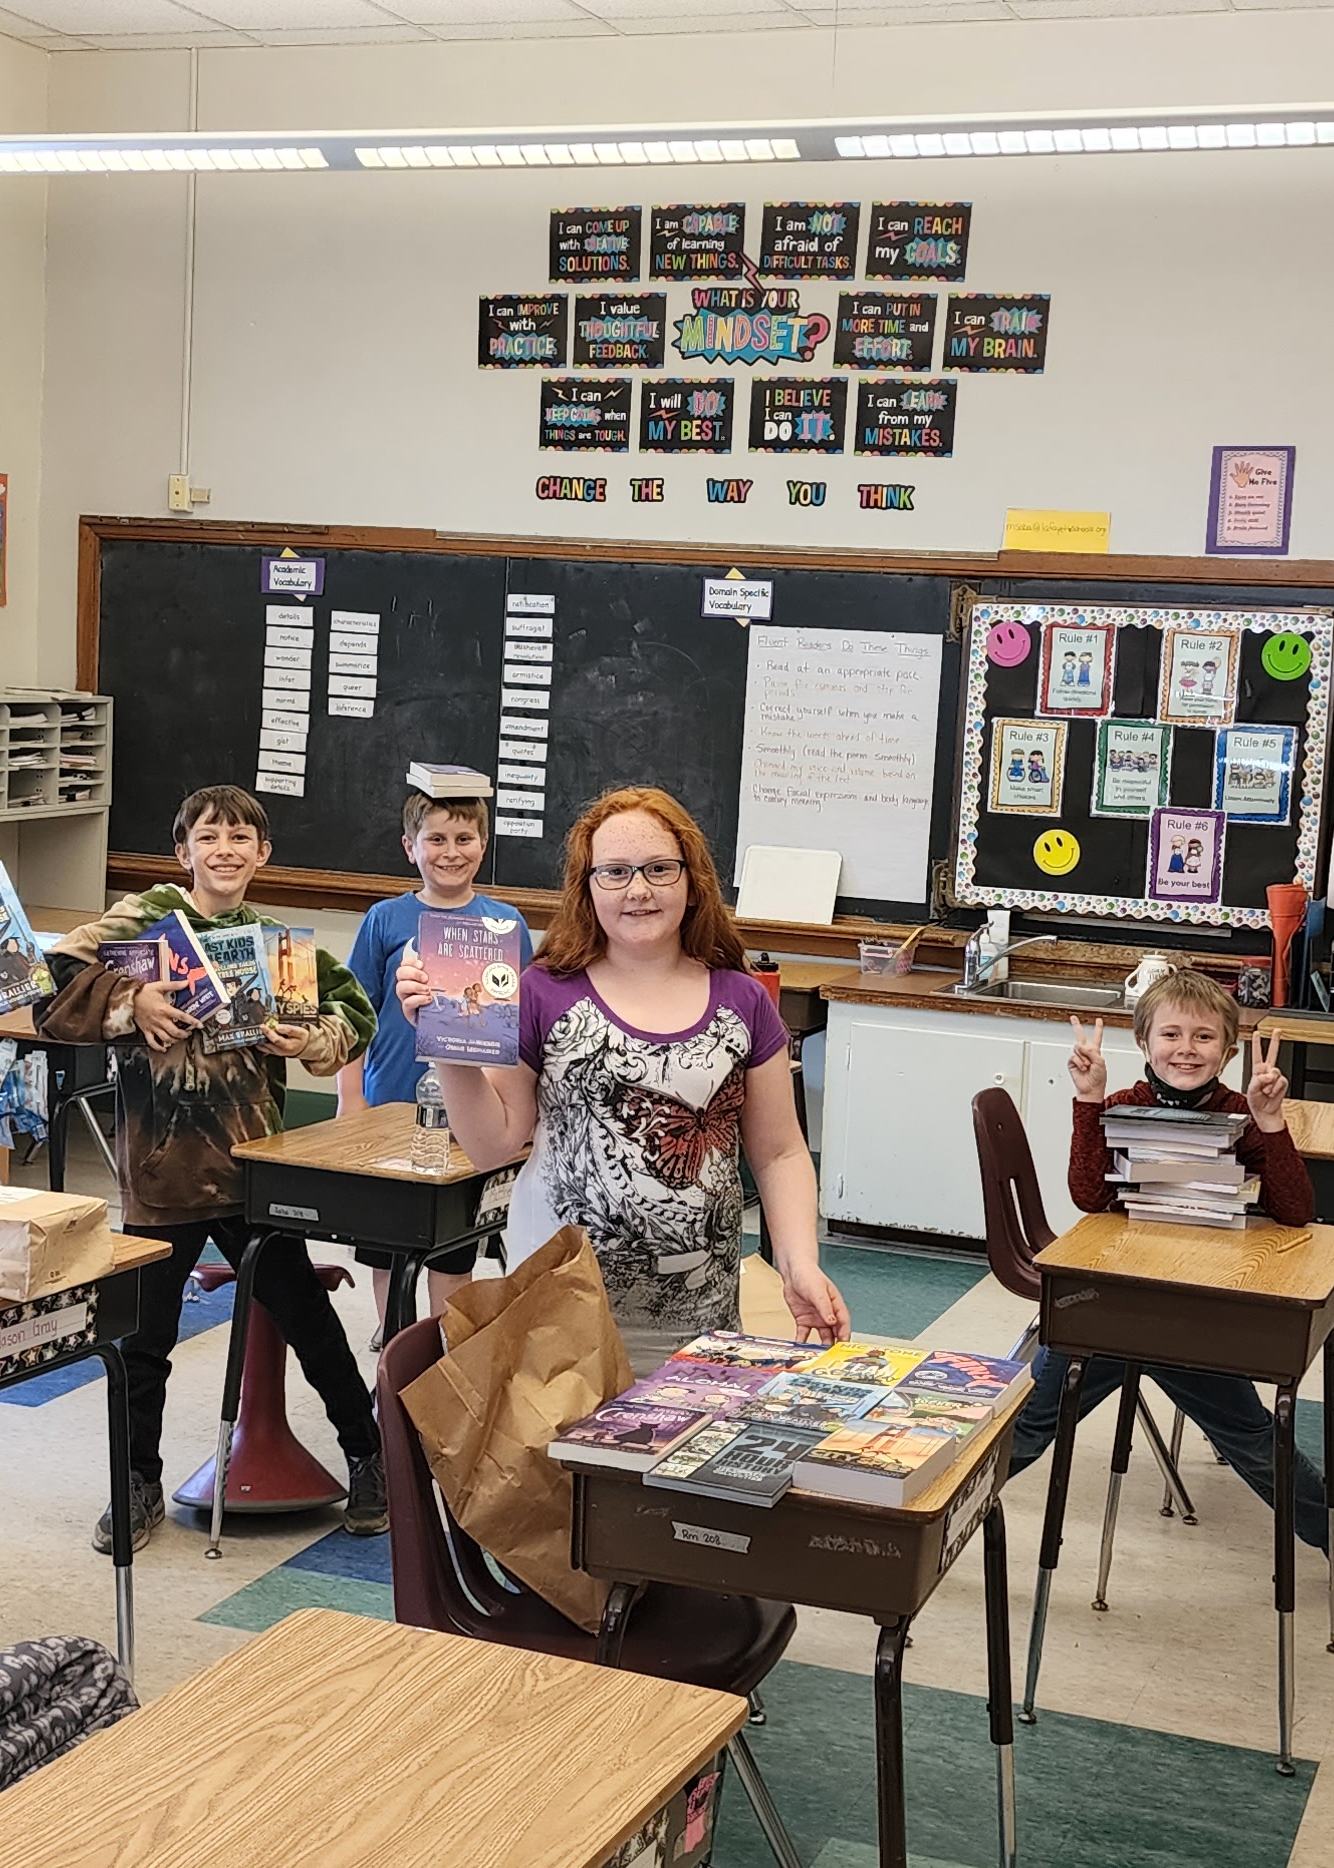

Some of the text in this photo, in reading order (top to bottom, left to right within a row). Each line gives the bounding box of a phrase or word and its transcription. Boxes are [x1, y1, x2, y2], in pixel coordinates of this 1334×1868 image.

[566, 220, 630, 234] can COME UP
[664, 217, 737, 232] am CAPABLE
[786, 214, 841, 232] am NOT
[888, 217, 963, 236] can REACH
[559, 240, 580, 252] with
[667, 238, 725, 254] of learning
[774, 237, 843, 252] afraid of
[875, 245, 899, 265] my
[559, 256, 630, 273] SOLUTIONS.
[655, 254, 739, 272] NEW THINGS.
[764, 256, 852, 270] DIFFICULT TASKS.
[694, 290, 798, 308] WHAT IS YOUR
[496, 303, 559, 318] can IMPROVE
[610, 302, 640, 316] value
[862, 303, 908, 316] can PUT
[509, 320, 536, 334] with
[842, 319, 928, 334] MORE TIME and
[964, 316, 986, 326] can
[578, 321, 660, 340] THOUGHTFUL
[681, 313, 830, 361] MINDSET?
[489, 338, 557, 357] PRACTICE.
[950, 338, 1038, 359] MY BRAIN.
[581, 392, 601, 402] can
[660, 394, 682, 409] will
[774, 389, 831, 407] BELIEVE
[877, 396, 897, 408] can
[604, 410, 627, 421] when
[773, 410, 792, 421] can
[878, 412, 932, 430] from my
[648, 421, 676, 441] MY
[764, 412, 836, 442] DO IT.
[545, 430, 628, 442] THINGS are TOUGH.
[864, 428, 942, 450] MISTAKES.
[536, 478, 916, 511] CHANGE THE WAY YOU THINK
[273, 564, 306, 576] Academic
[274, 578, 313, 592] Vocabulary
[709, 586, 769, 600] Domain Specific
[709, 600, 752, 614] Vocabulary
[280, 633, 300, 644] notice
[1058, 632, 1099, 644] Rule #1
[1180, 638, 1224, 652] Rule #2
[757, 636, 929, 660] Fluent Do Things
[766, 660, 891, 682] Read at an appropriate
[796, 706, 832, 722] yourself
[1009, 730, 1050, 743] Rule #3
[1114, 730, 1155, 743] Rule #4
[1233, 736, 1278, 750] Rule #5
[1167, 819, 1209, 832] Rule #6
[1158, 876, 1210, 891] Be your best
[227, 934, 255, 950] KIDS
[443, 926, 498, 946] WHEN STARS
[438, 942, 504, 962] ARE SCATTERED
[104, 956, 156, 978] Crenshaw
[287, 1003, 317, 1016] SPIES
[32, 1319, 58, 1338] Gray
[666, 1374, 751, 1392] ALOHA!
[596, 1407, 691, 1424] Crenshaw
[730, 1436, 813, 1459] 24
[723, 1451, 795, 1466] HOUR
[809, 1450, 854, 1462] CITY
[682, 1529, 698, 1541] Rm
